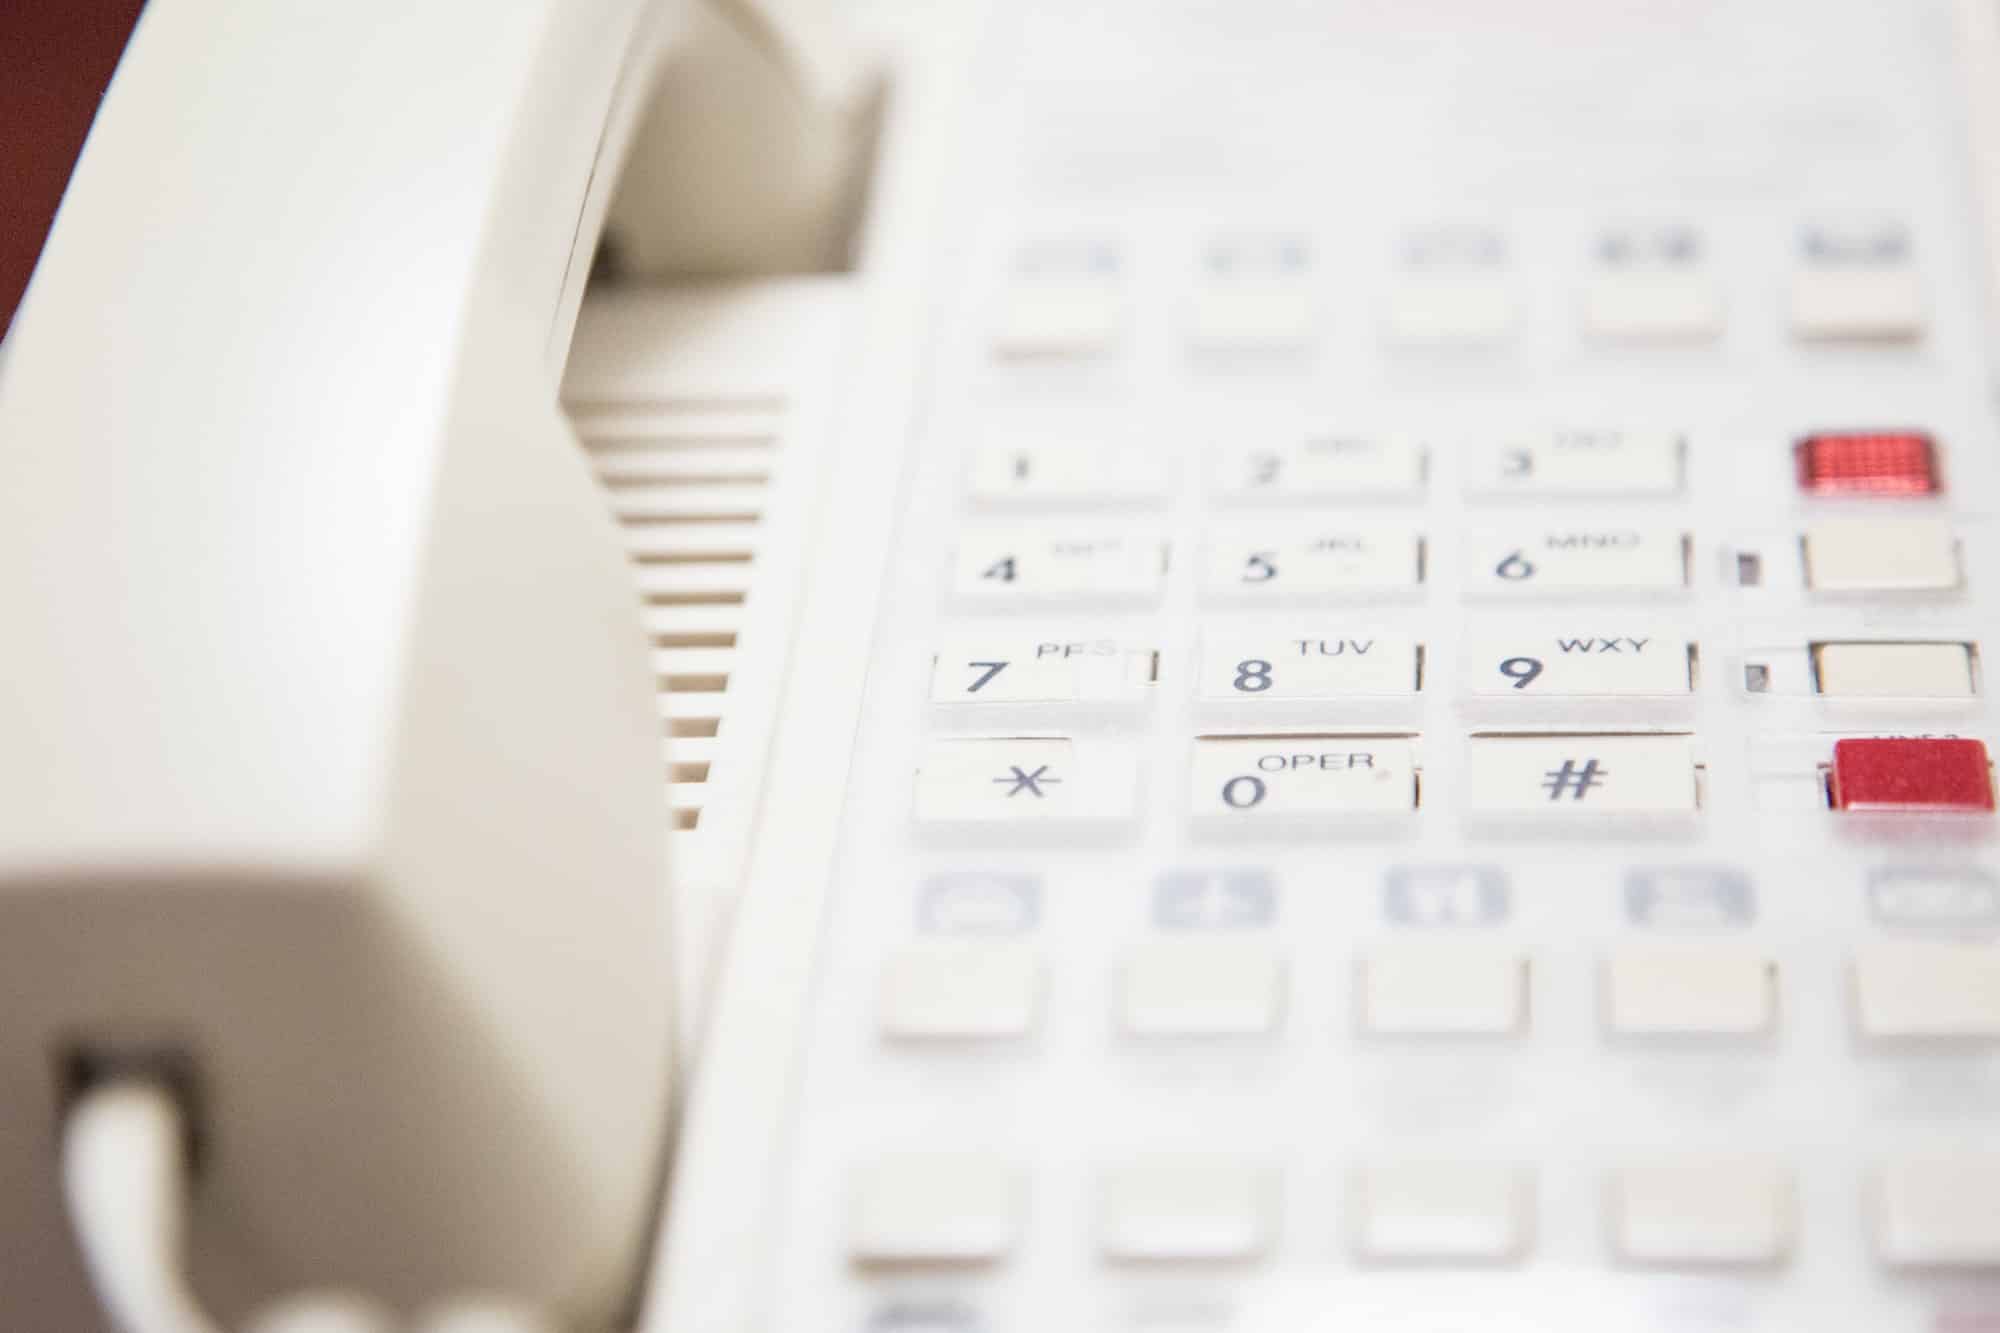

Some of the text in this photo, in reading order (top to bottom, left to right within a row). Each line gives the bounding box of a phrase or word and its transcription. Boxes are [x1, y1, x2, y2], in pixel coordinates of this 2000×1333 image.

[1499, 448, 1534, 478] 3
[981, 555, 1018, 583] 4
[1242, 551, 1279, 584] 5
[1495, 549, 1536, 581] 6
[1295, 639, 1374, 657] TUV
[1557, 638, 1650, 654] WXY
[967, 661, 1010, 693] 7
[1232, 659, 1273, 693] 8
[1499, 656, 1544, 690] 9
[1257, 752, 1375, 772] OPER
[1541, 759, 1609, 801] #
